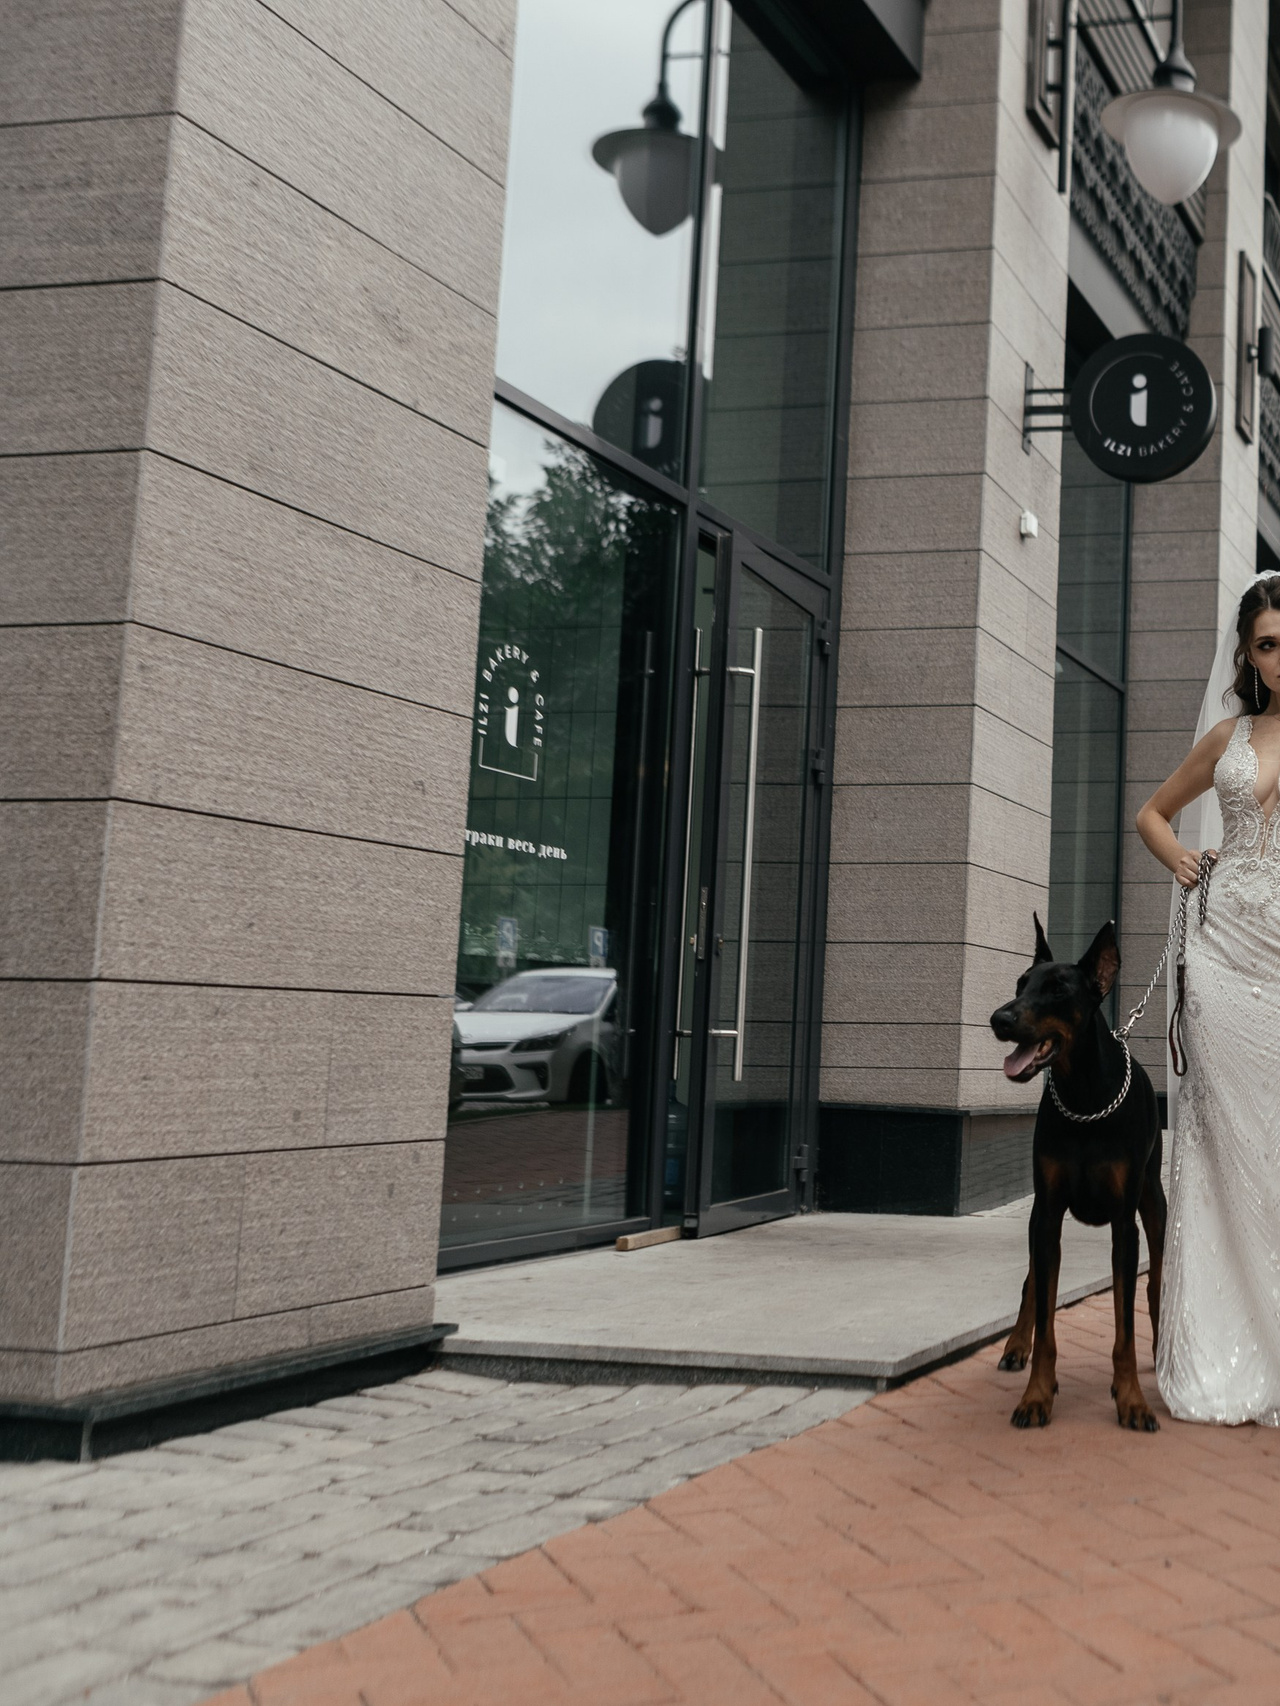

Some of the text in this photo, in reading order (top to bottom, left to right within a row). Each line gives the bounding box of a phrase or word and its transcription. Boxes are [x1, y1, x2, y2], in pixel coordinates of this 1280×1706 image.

[1103, 437, 1132, 457] ILZI
[1138, 418, 1187, 457] BAKERY
[1169, 361, 1194, 397] CAFE
[1130, 373, 1148, 427] i
[482, 644, 530, 682] BAKERY
[477, 692, 490, 735] ILZI
[533, 693, 545, 748] CAFE
[507, 837, 536, 855] весь
[537, 843, 568, 861] день
